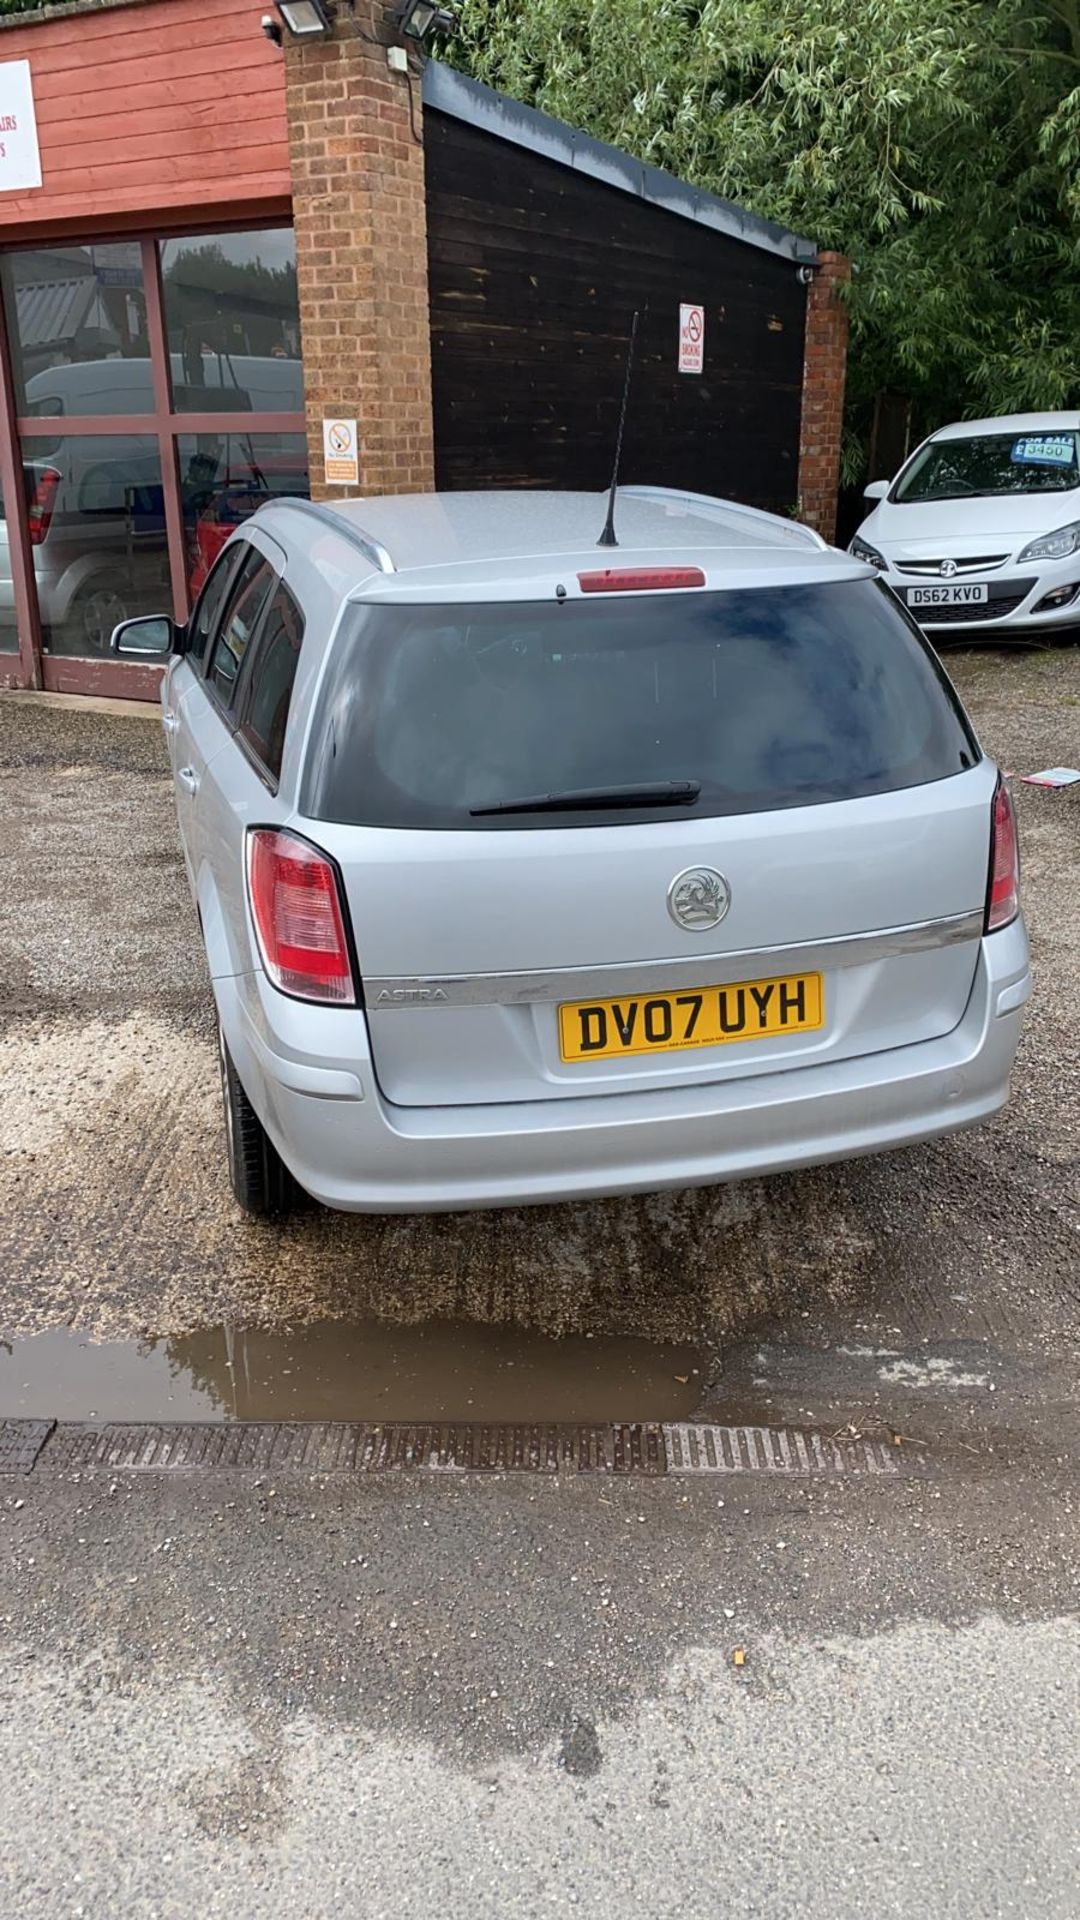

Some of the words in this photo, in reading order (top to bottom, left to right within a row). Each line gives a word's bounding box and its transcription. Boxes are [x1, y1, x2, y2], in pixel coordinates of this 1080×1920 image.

[1044, 436, 1074, 446] SALE
[1028, 445, 1063, 456] 3450
[914, 588, 950, 603] DS62
[953, 586, 982, 602] KVO
[376, 988, 449, 1002] ASTRA
[578, 995, 703, 1051] DV07
[718, 980, 806, 1034] UYH
